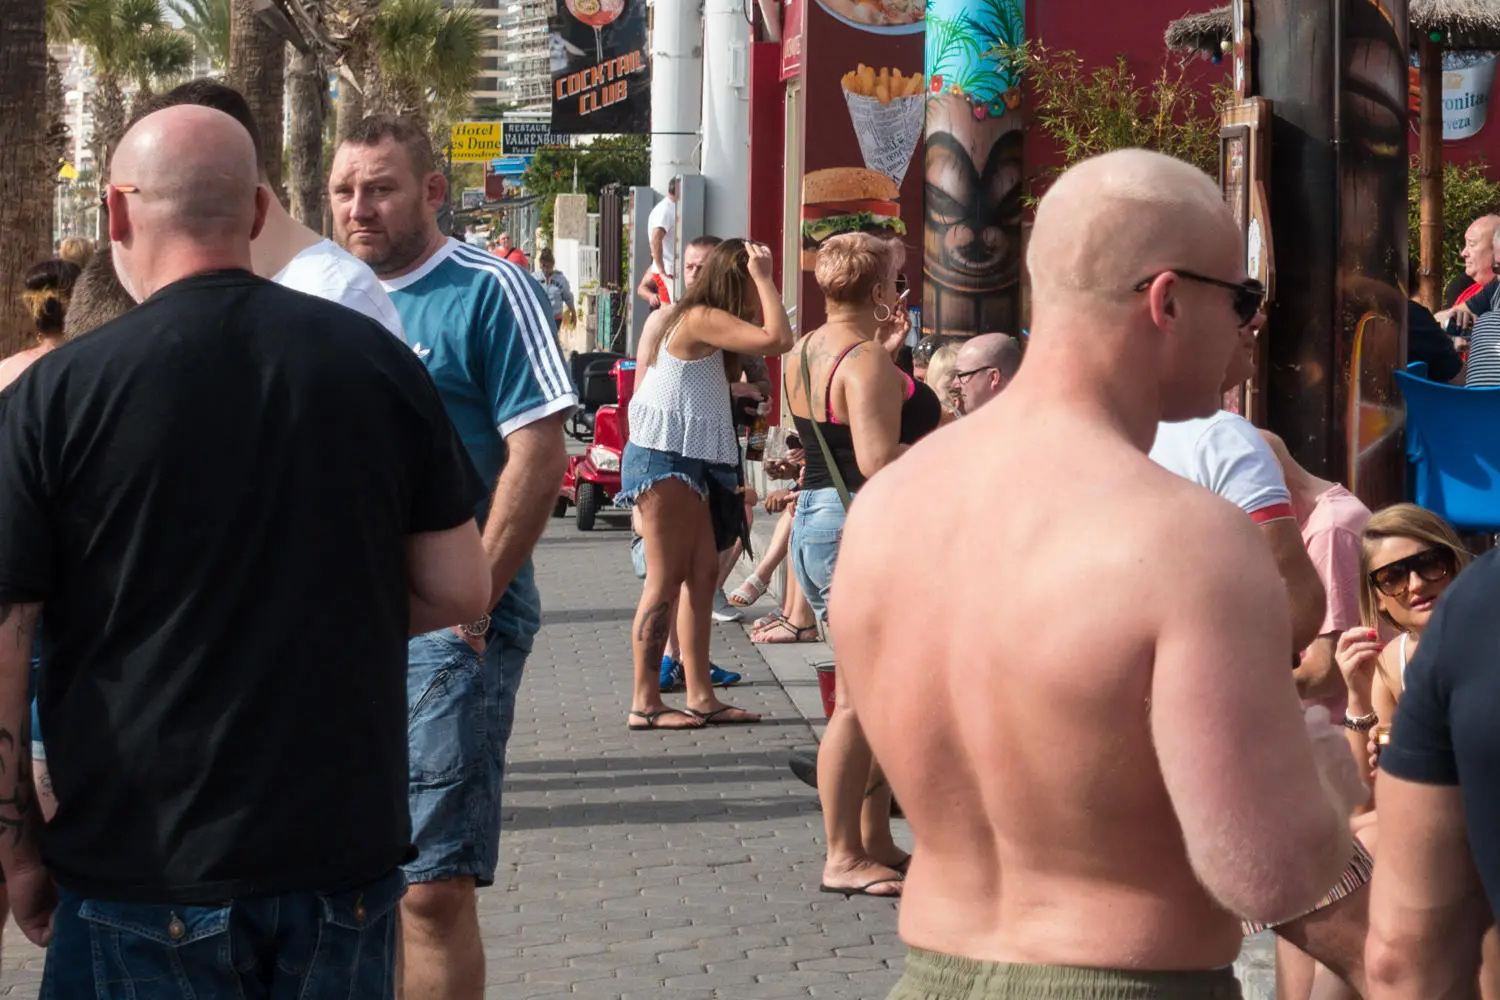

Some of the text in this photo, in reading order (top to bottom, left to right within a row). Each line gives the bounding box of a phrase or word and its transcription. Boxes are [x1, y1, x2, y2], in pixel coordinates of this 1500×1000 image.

[556, 50, 646, 100] COCKTAIL
[579, 79, 628, 116] CLUB
[456, 124, 494, 136] Hotel
[504, 133, 570, 146] VALKENBURG
